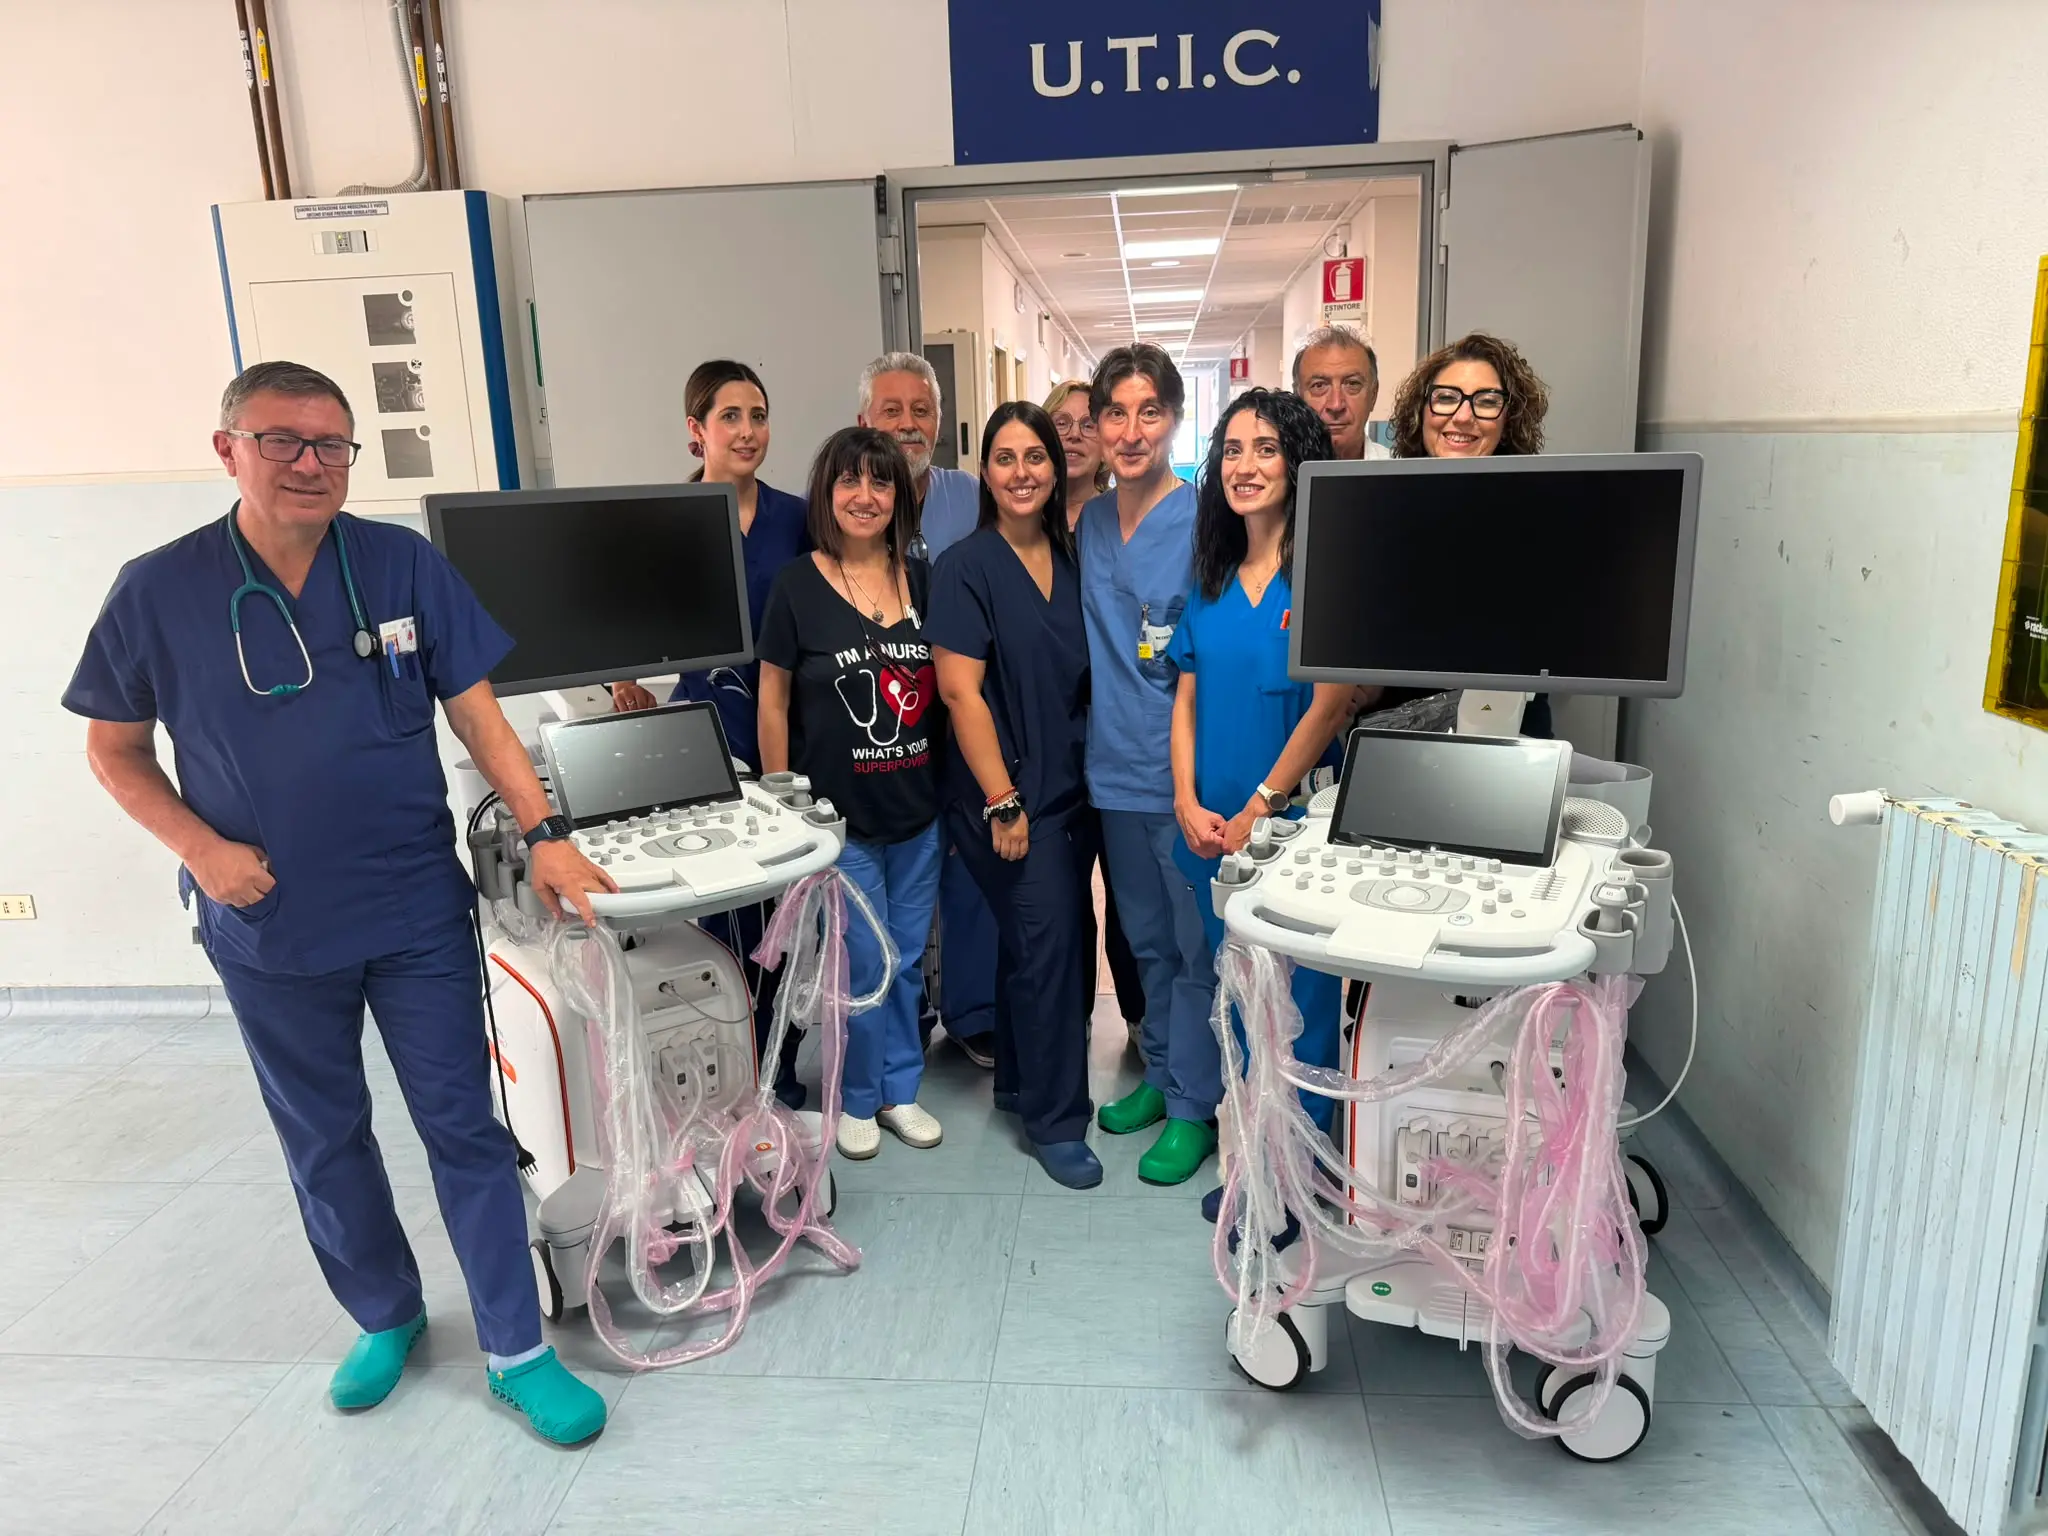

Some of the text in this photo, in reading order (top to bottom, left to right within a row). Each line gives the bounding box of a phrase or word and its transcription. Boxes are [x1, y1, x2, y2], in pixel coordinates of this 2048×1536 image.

[1029, 29, 1302, 98] U.T.I.C.
[1324, 303, 1361, 312] ESTINTORE
[835, 647, 861, 668] I'M
[880, 643, 933, 660] NURS
[852, 737, 929, 760] WHAT'S YOUR
